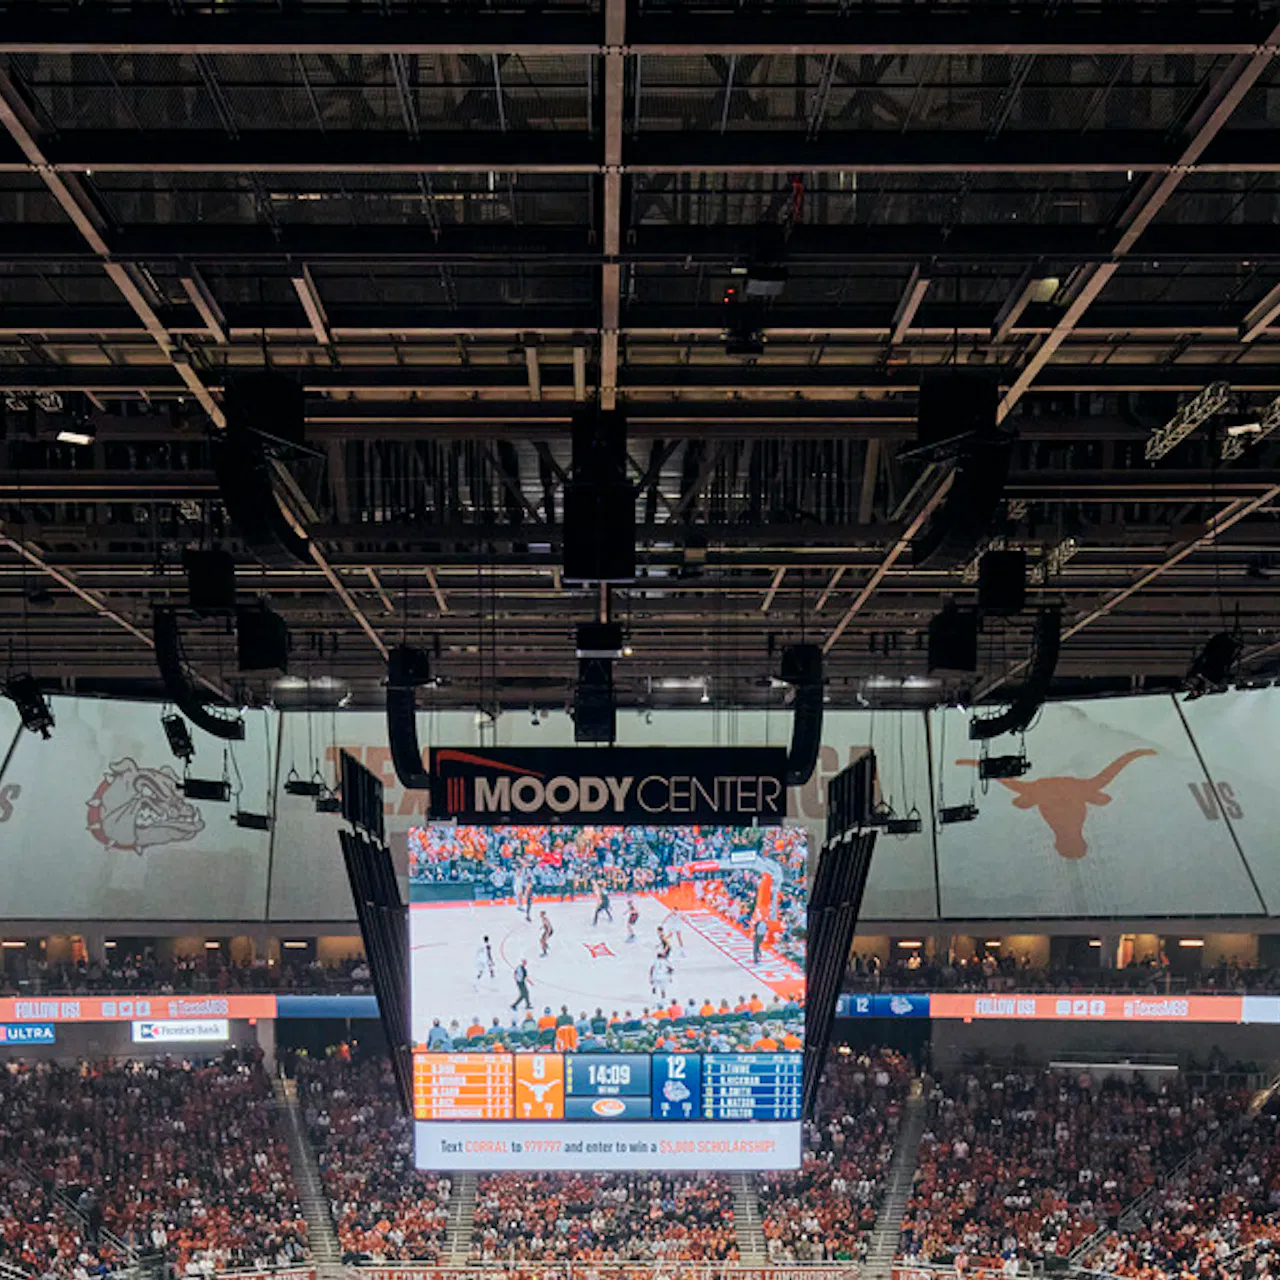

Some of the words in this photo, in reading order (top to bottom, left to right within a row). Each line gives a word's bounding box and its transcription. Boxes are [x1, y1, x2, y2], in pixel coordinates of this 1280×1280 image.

[474, 775, 635, 812] MOODY
[637, 775, 782, 813] CENTER
[1187, 780, 1243, 821] VS
[15, 1001, 59, 1019] FOLLOW
[857, 998, 869, 1013] 12
[975, 998, 1015, 1014] FOLLOW
[7, 1027, 54, 1041] ULTRA
[533, 1056, 546, 1079] 9
[588, 1064, 631, 1085] 14:09
[666, 1055, 687, 1079] 12
[441, 1140, 464, 1152] Text
[465, 1140, 508, 1153] CORRAL
[512, 1140, 523, 1152] to
[524, 1140, 562, 1153] 979797
[564, 1140, 584, 1153] and
[585, 1142, 613, 1153] enter
[616, 1140, 627, 1153] to
[629, 1140, 648, 1153] win
[650, 1142, 658, 1153] a
[659, 1140, 695, 1154] $5,000
[697, 1140, 776, 1153] SCHOLARSHIP!
